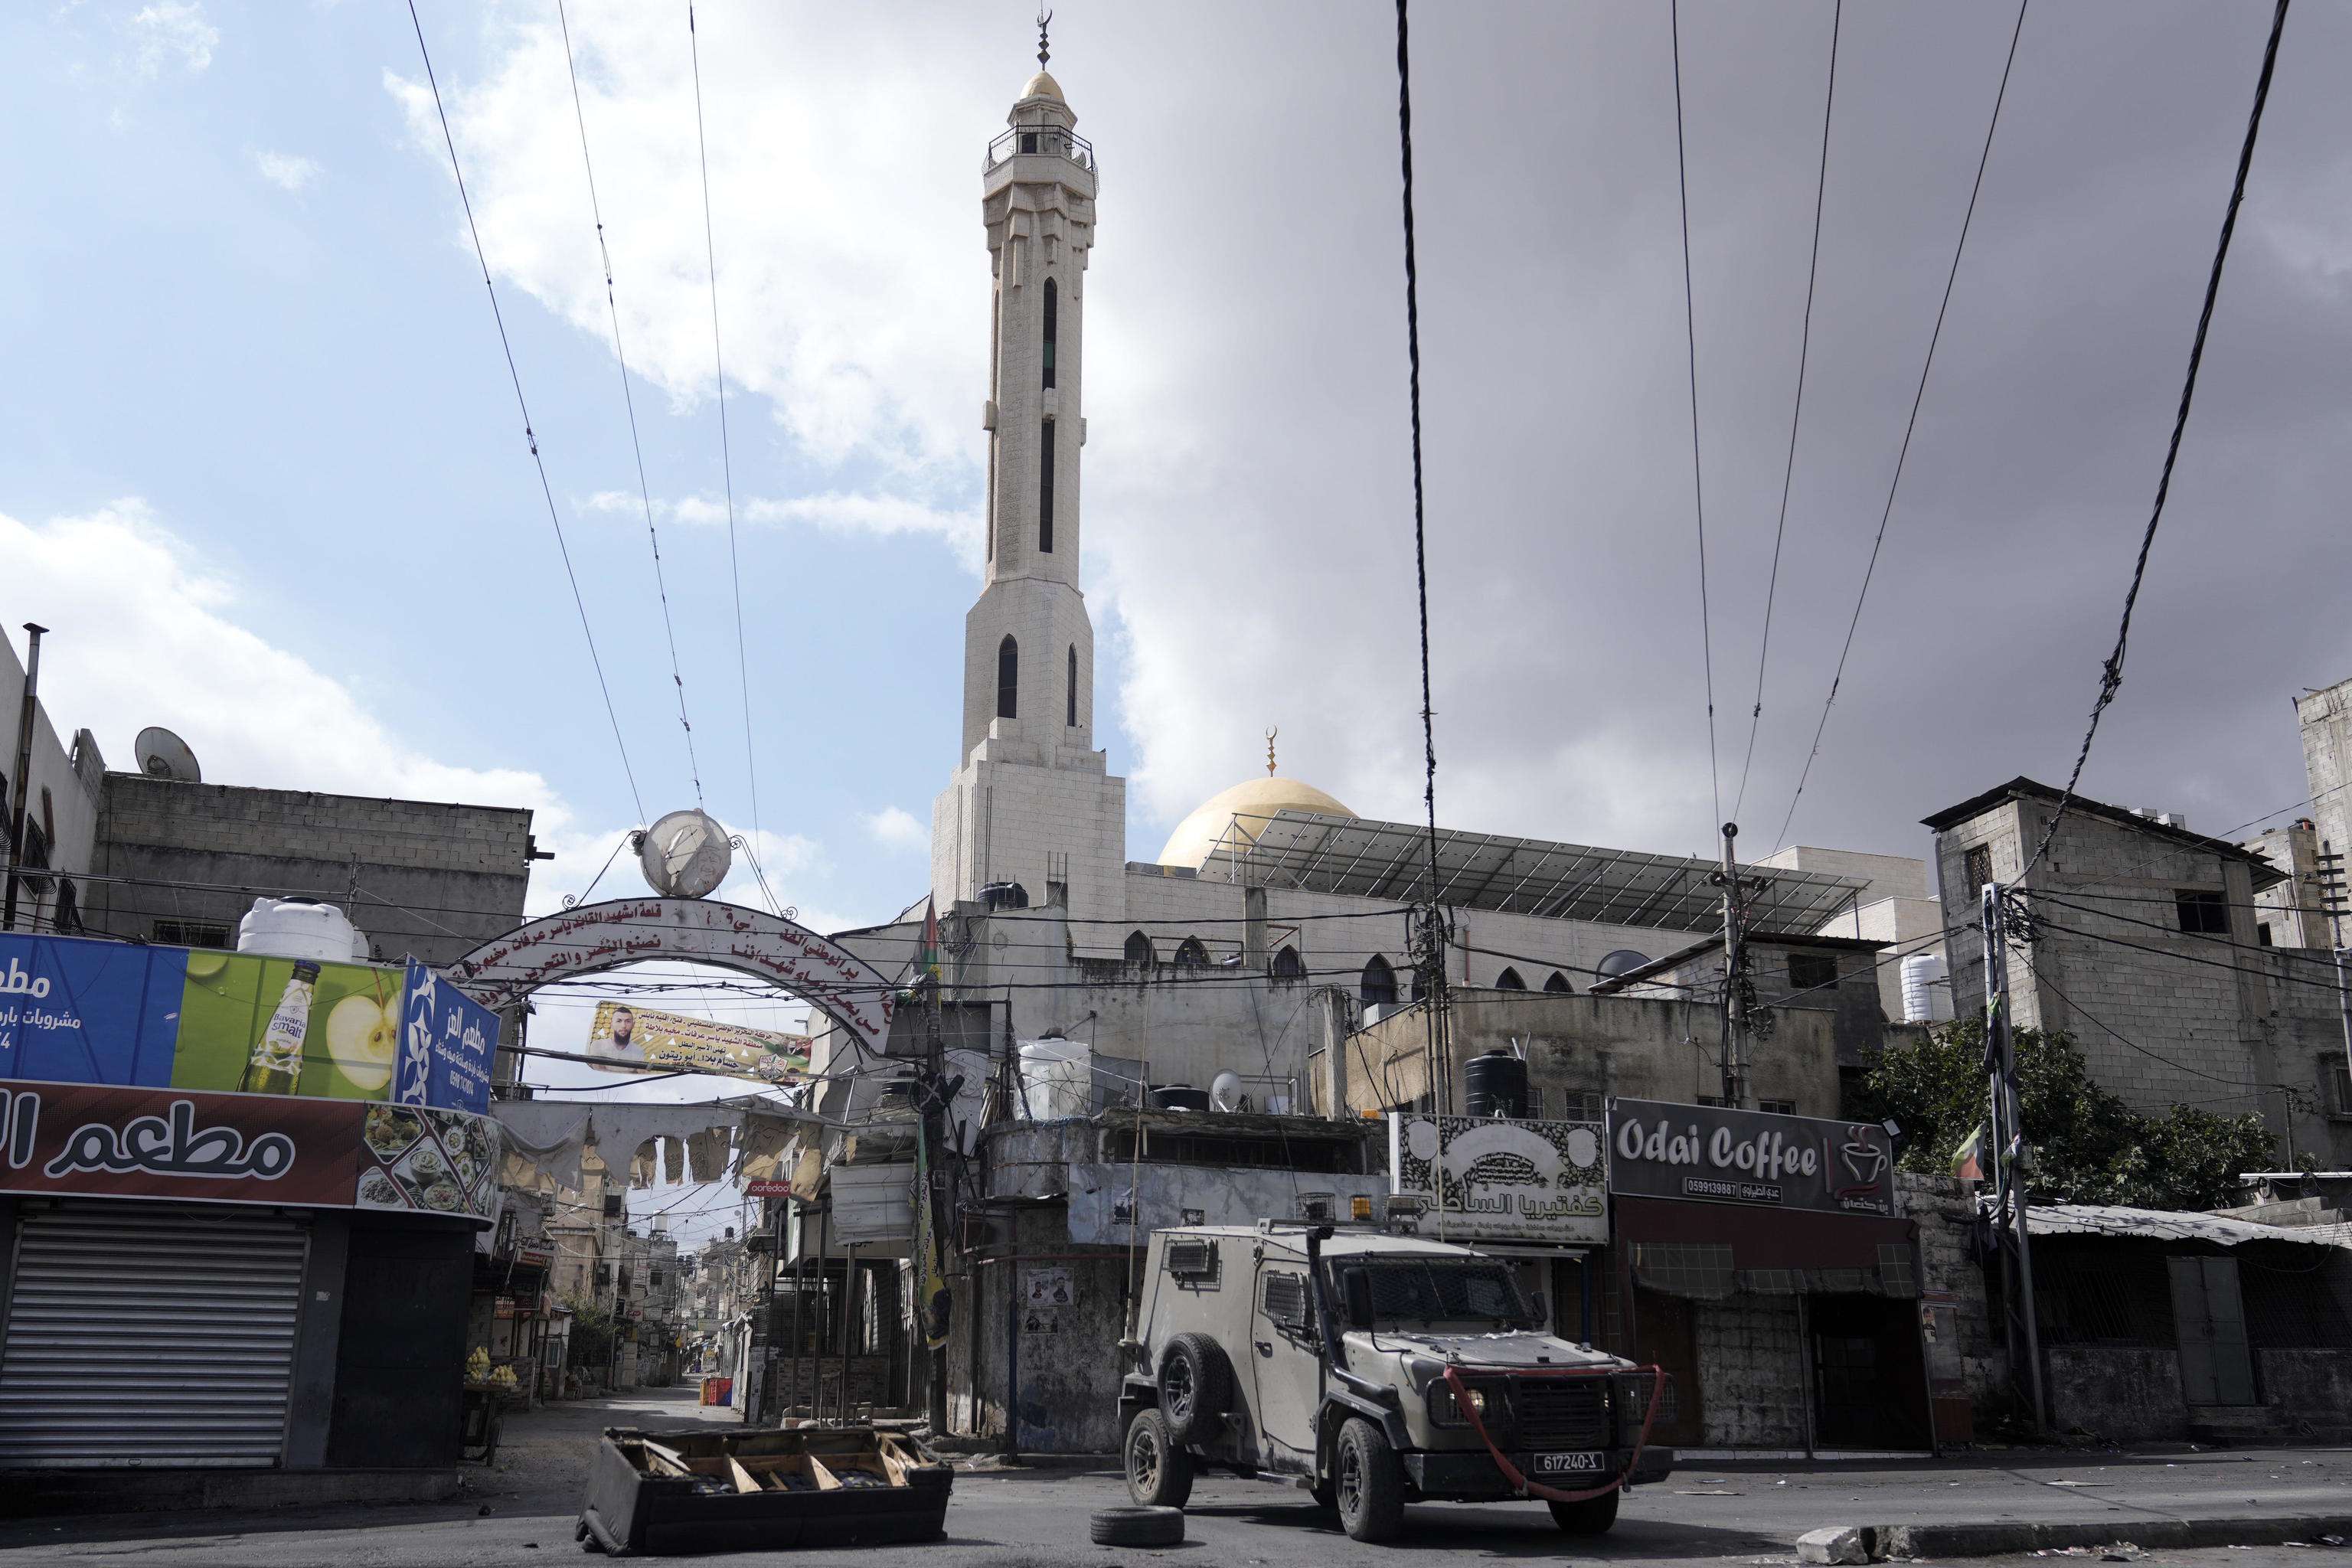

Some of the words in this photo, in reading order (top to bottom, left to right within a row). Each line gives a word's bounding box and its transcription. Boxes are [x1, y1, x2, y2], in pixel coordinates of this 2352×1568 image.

[549, 920, 572, 939] ياسر
[512, 930, 546, 951] عرفات
[626, 933, 662, 955] نصنع
[483, 947, 508, 971] مخيم
[0, 958, 51, 998] مط
[22, 1008, 81, 1030] مشروبات
[273, 1014, 306, 1028] Bavaria
[638, 1011, 655, 1020] نابلس
[645, 1022, 664, 1032] بلاطة
[687, 1018, 716, 1030] الفلسطيني
[715, 1022, 734, 1033] الوطني
[462, 1018, 485, 1056] مطعم
[685, 1029, 705, 1039] عرفات
[705, 1034, 721, 1043] ياسر
[733, 1027, 754, 1037] التحرير
[754, 1030, 773, 1041] حركة
[722, 1035, 743, 1046] الشهيد
[744, 1040, 763, 1050] منطقة
[658, 1050, 683, 1061] زيتون
[717, 1056, 739, 1069] حسام
[44, 1100, 296, 1180] مطعم
[1616, 1118, 1700, 1165] Odai
[1709, 1127, 1818, 1181] Coffee
[751, 1184, 789, 1192] ooredoo
[1688, 1180, 1736, 1195] 0599139887
[1742, 1184, 1766, 1198] الطيراوي
[1766, 1187, 1779, 1199] عدي
[1417, 1193, 1512, 1219] الساحلي
[1518, 1194, 1604, 1220] كفتيريا
[1878, 1199, 1889, 1216] بن
